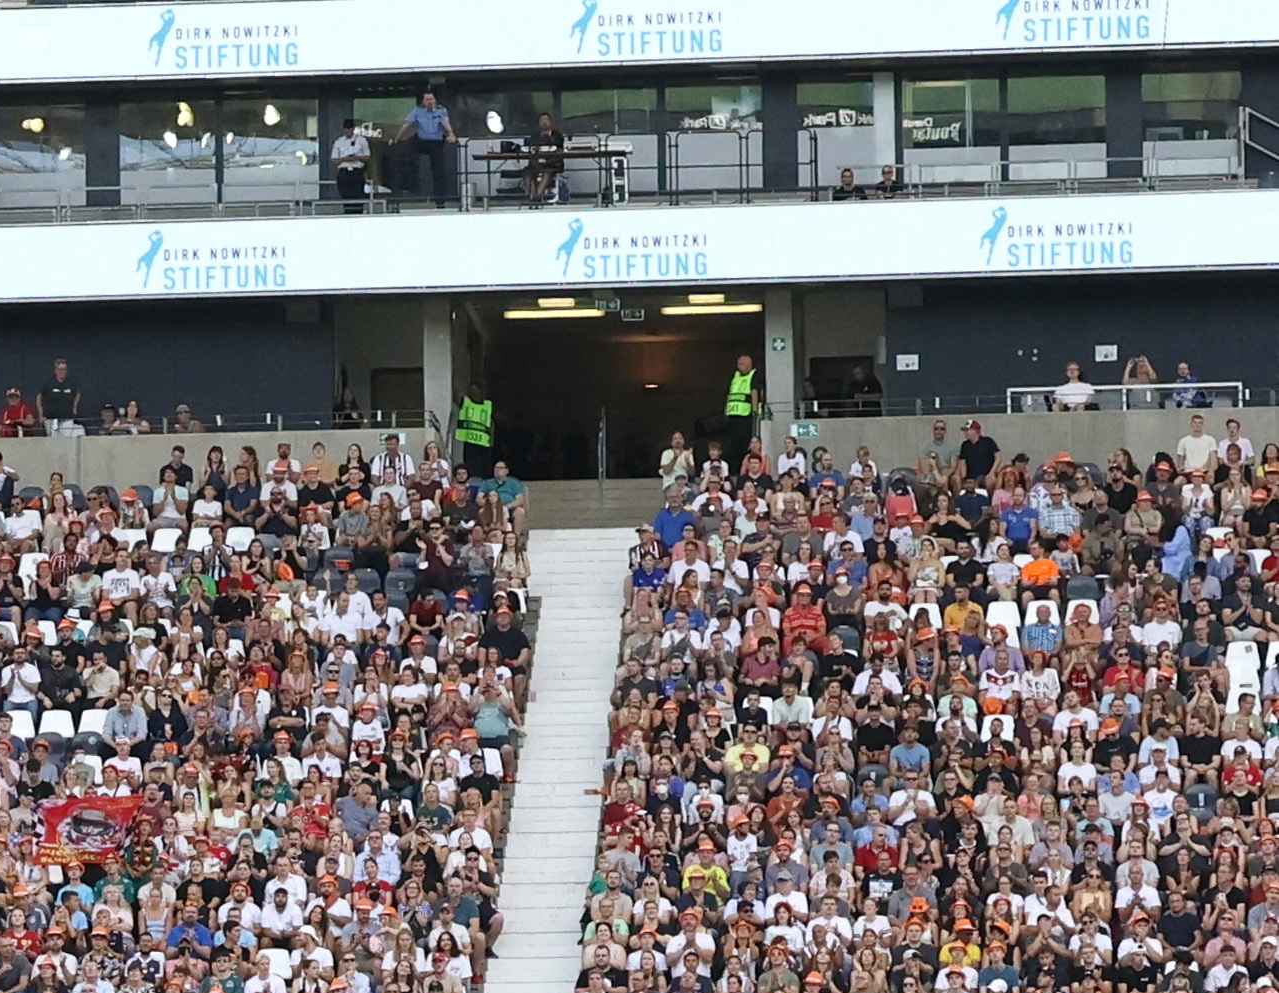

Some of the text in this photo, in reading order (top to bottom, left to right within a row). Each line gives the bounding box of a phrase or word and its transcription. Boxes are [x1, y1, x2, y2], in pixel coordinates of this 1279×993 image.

[1023, 0, 1061, 13] DIRK
[597, 11, 722, 27] DIRK NOWITZKI
[1023, 14, 1150, 43] STIFTUNG
[175, 25, 298, 41] DIRK NOWITZKI
[597, 28, 723, 57] STIFTUNG
[174, 42, 299, 70] STIFTUNG
[1007, 222, 1133, 239] DIRK NOWITZKI
[583, 234, 707, 250] DIRK NOWITZKI
[163, 246, 286, 262] DIRK NOWITZKI
[1007, 239, 1133, 268] STIFTUNG
[583, 251, 708, 279] STIFTUNG
[163, 263, 286, 291] STIFTUNG
